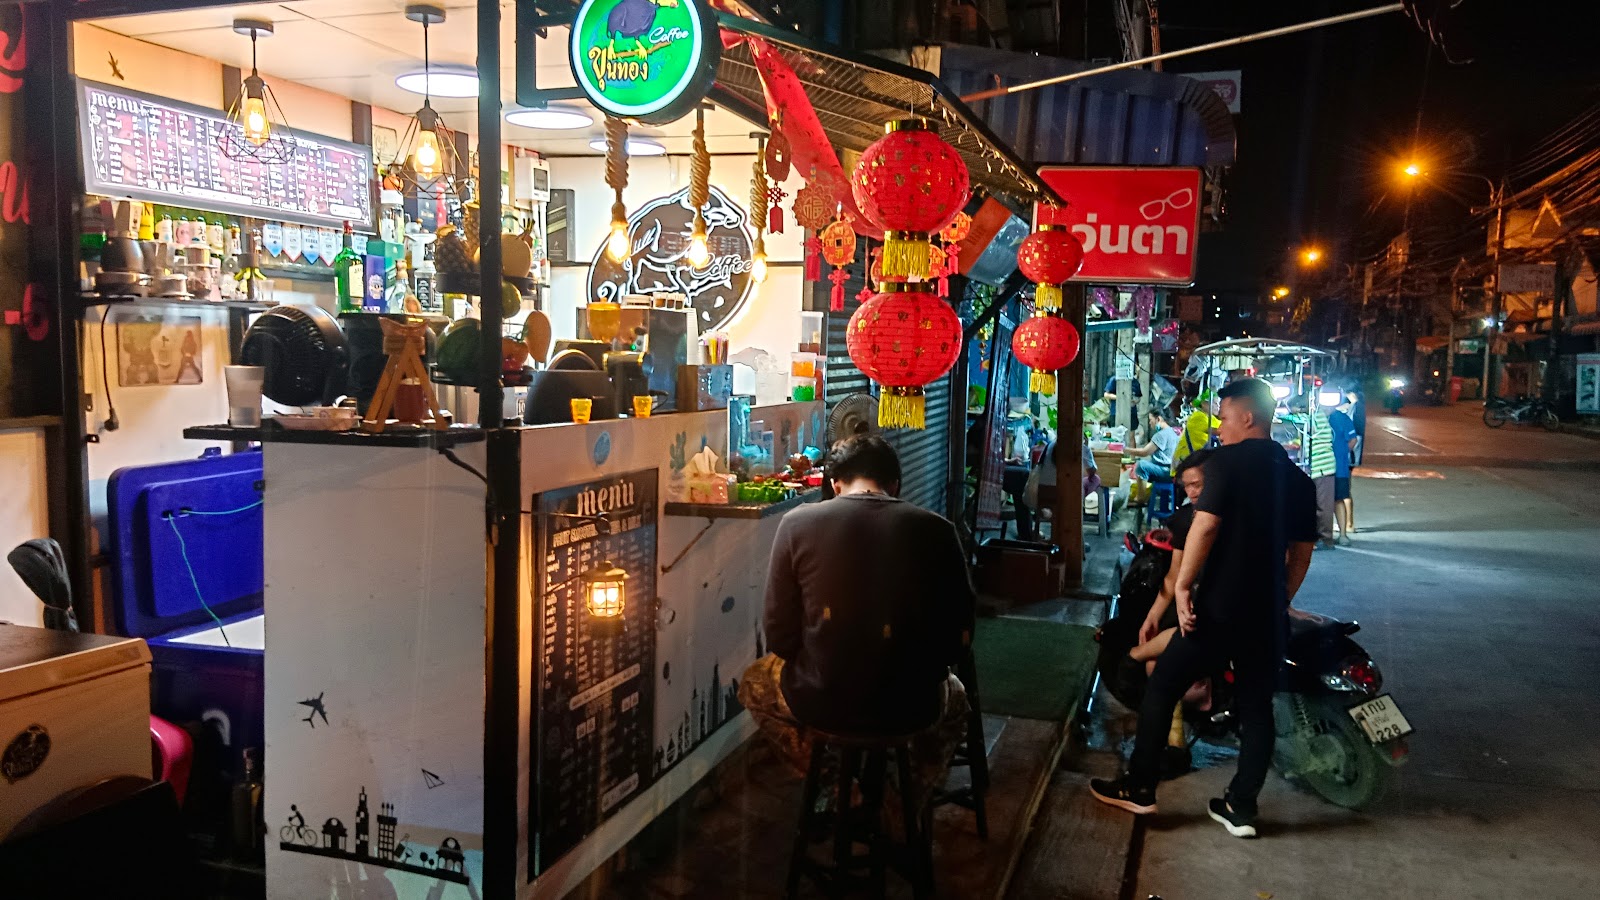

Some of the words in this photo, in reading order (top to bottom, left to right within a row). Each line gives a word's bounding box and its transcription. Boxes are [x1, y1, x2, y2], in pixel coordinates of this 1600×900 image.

[648, 26, 689, 44] Coffee
[588, 46, 649, 92] ขุนทอง
[91, 91, 139, 114] menu
[1071, 213, 1188, 255] ว่นตา
[577, 479, 635, 517] menu
[1376, 723, 1402, 741] 228
